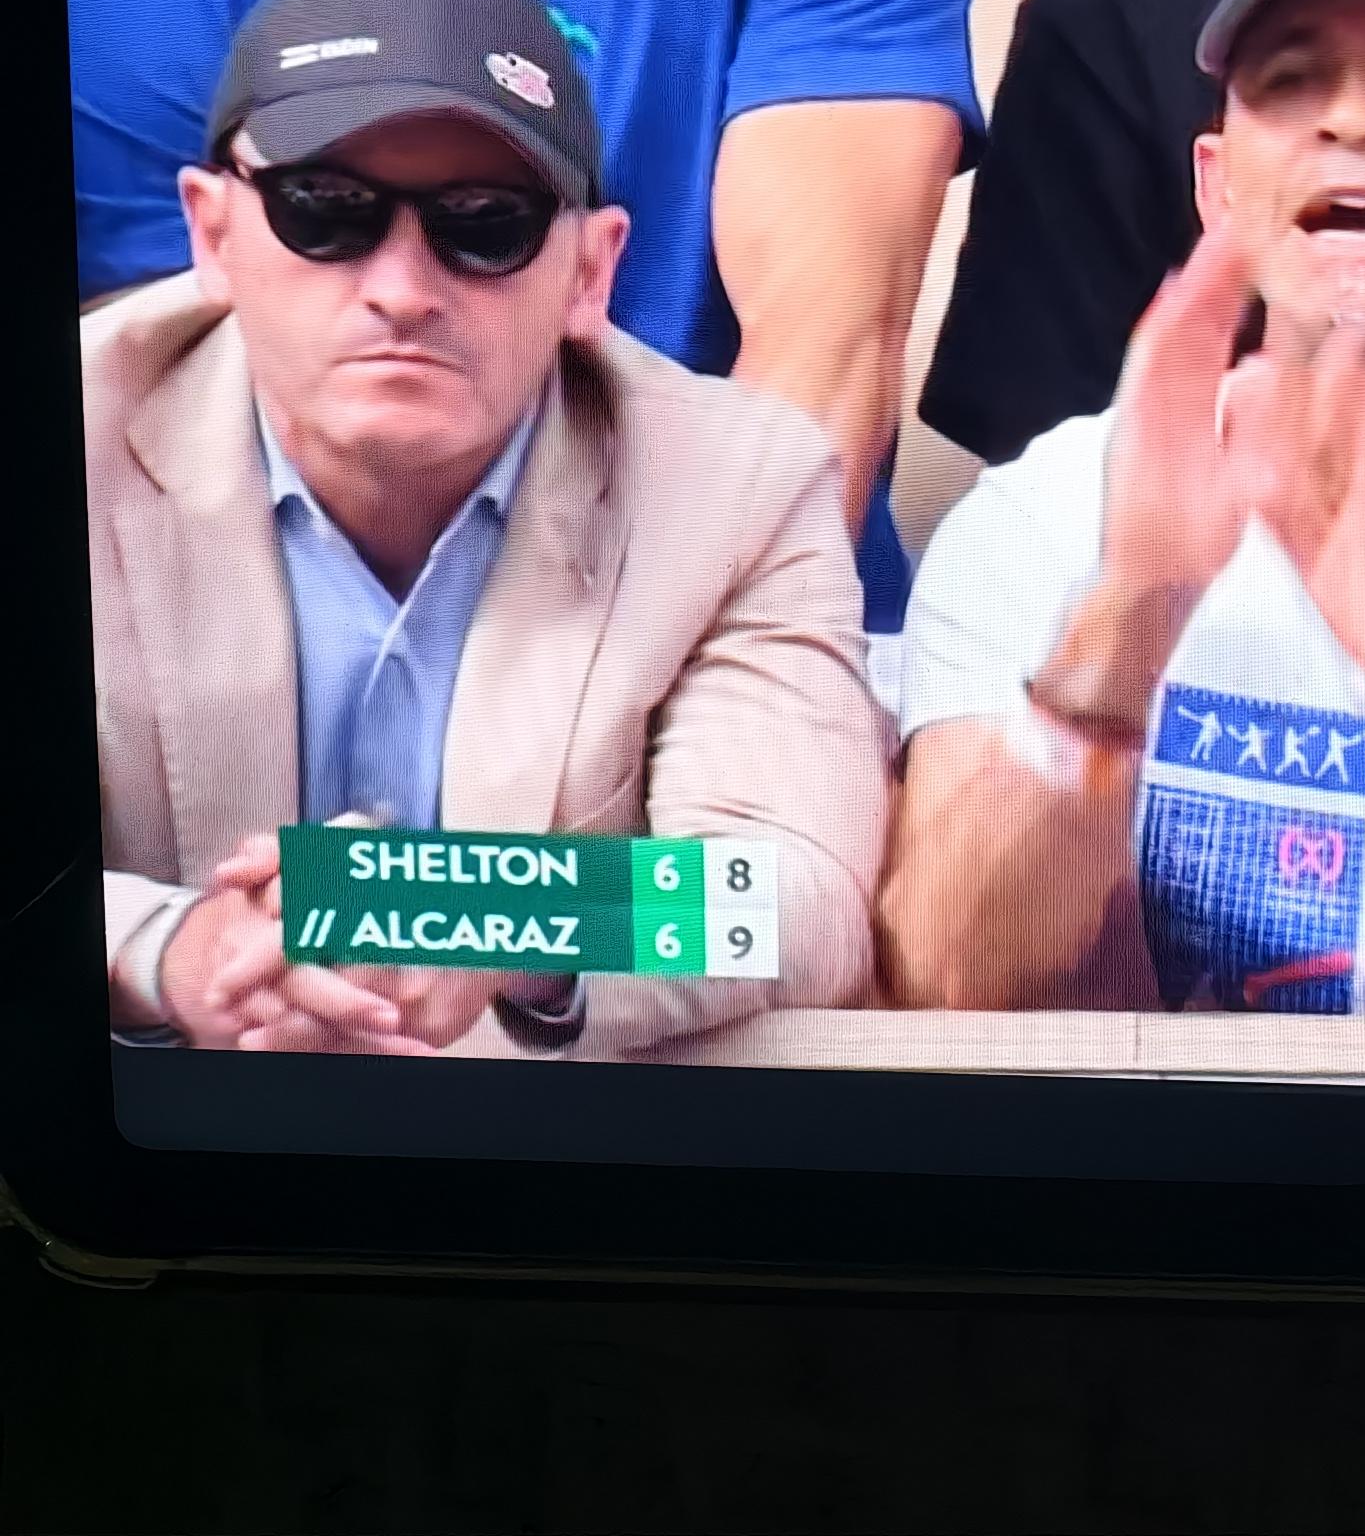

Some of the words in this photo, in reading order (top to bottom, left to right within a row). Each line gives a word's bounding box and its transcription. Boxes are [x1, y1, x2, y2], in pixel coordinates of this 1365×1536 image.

[348, 841, 578, 887] SHELTON
[652, 854, 681, 892] 6
[726, 857, 753, 893] 8
[349, 911, 581, 956] ALCARAZ
[654, 922, 683, 960] 6
[727, 925, 754, 960] 9
